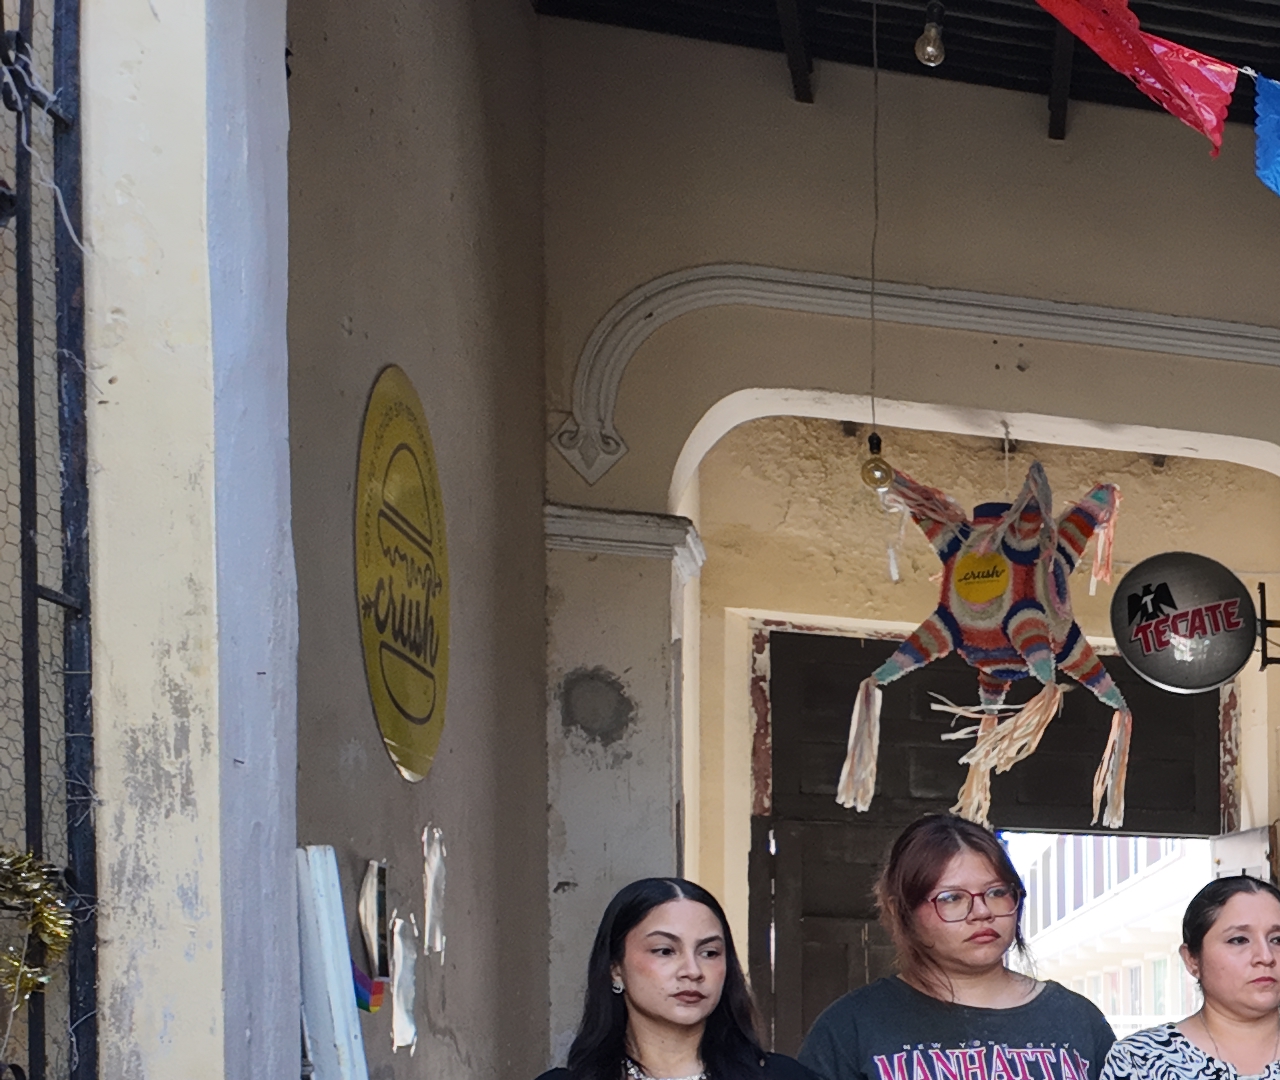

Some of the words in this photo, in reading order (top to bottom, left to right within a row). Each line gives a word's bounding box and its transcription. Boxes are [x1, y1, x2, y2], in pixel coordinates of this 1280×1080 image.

[960, 565, 1004, 582] crush
[1131, 597, 1244, 656] TECATE
[902, 1042, 942, 1051] NEW
